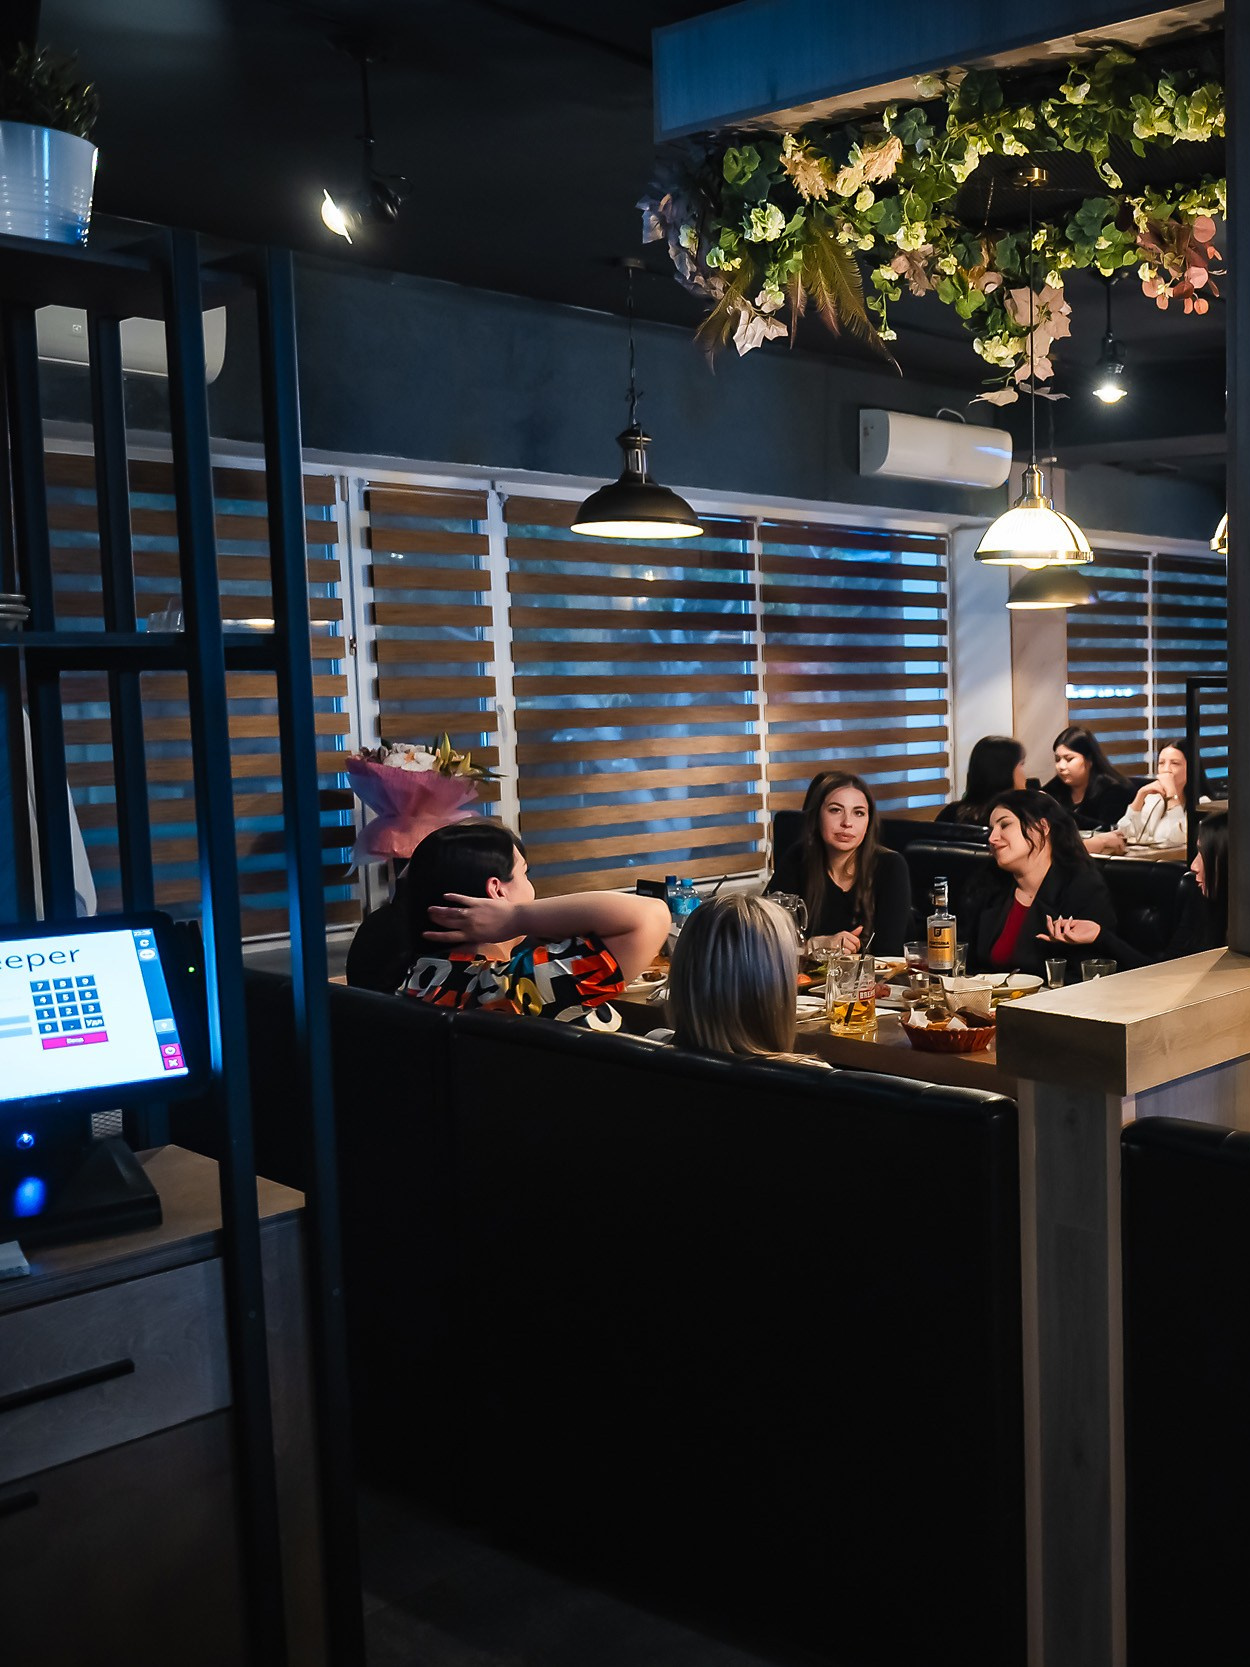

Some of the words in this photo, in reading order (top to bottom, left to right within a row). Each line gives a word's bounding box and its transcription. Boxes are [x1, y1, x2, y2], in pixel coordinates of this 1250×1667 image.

[0, 949, 80, 972] eper
[37, 982, 44, 990] 7
[81, 977, 89, 985] 9
[39, 996, 47, 1004] 4
[65, 1007, 73, 1015] 2
